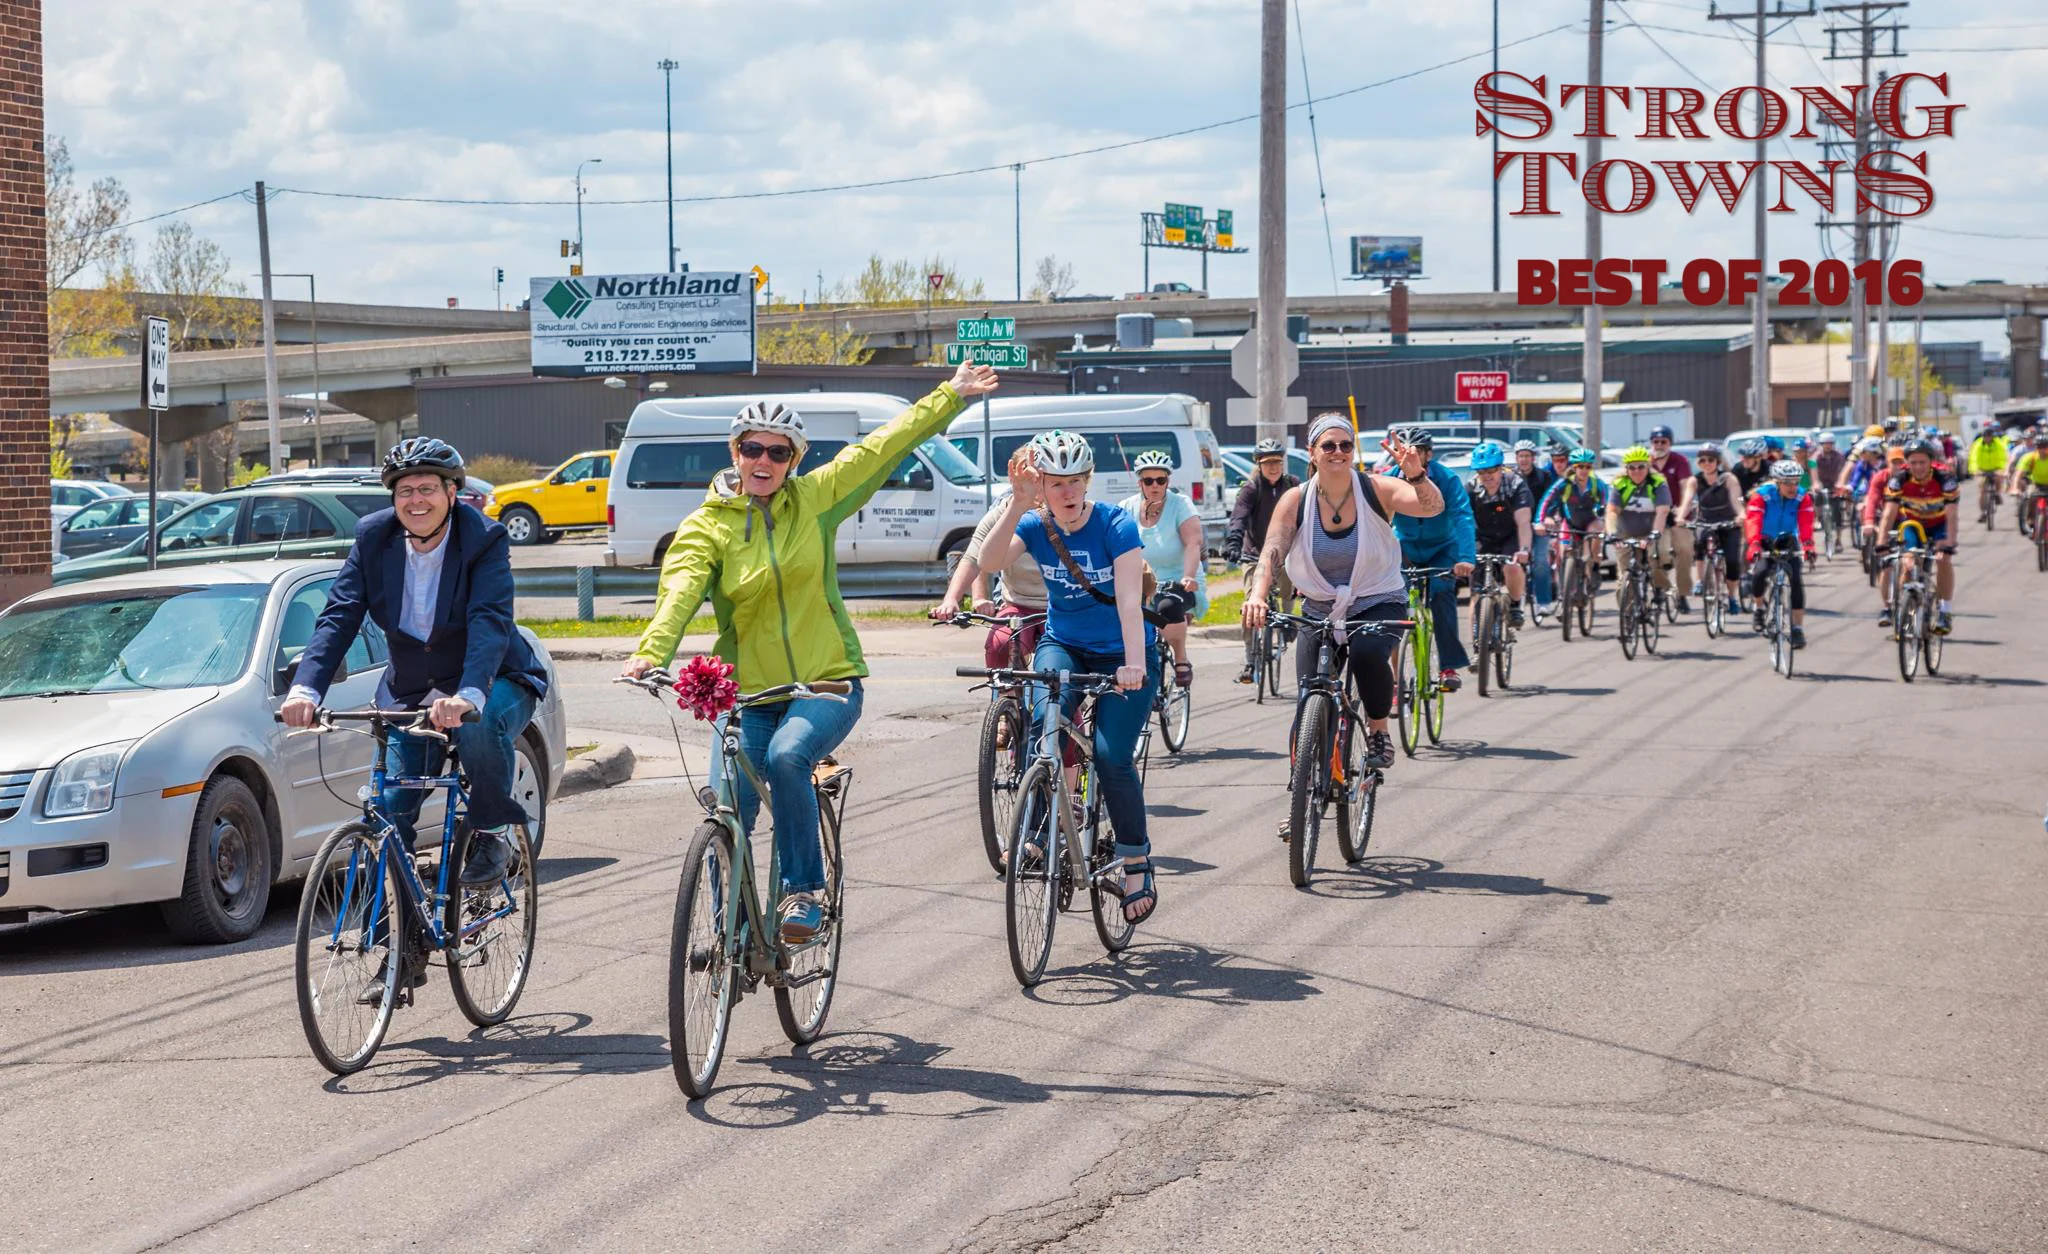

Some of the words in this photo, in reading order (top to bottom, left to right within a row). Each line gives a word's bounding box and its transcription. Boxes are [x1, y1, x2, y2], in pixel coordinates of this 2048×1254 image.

[595, 273, 741, 298] Northland
[616, 301, 655, 311] Consulting
[658, 300, 697, 311] Engineers
[581, 322, 599, 330] Civil
[601, 322, 617, 330] and
[619, 321, 655, 329] Forensic
[657, 319, 708, 330] Engineering
[710, 318, 747, 328] Services
[959, 321, 965, 338] S
[967, 321, 990, 338] 20th
[992, 321, 1004, 337] Av
[1005, 320, 1014, 337] W
[151, 325, 166, 346] ONE
[610, 338, 630, 347] you
[633, 337, 654, 346] can
[657, 336, 690, 345] count
[151, 349, 166, 370] WAY
[584, 348, 696, 362] 218.727.5995
[949, 345, 959, 361] W
[963, 345, 1008, 365] Michigan
[1012, 346, 1025, 362] St
[584, 363, 696, 373] www.nce-engineers.com
[1462, 376, 1504, 387] WRONG
[1469, 388, 1495, 399] WAY
